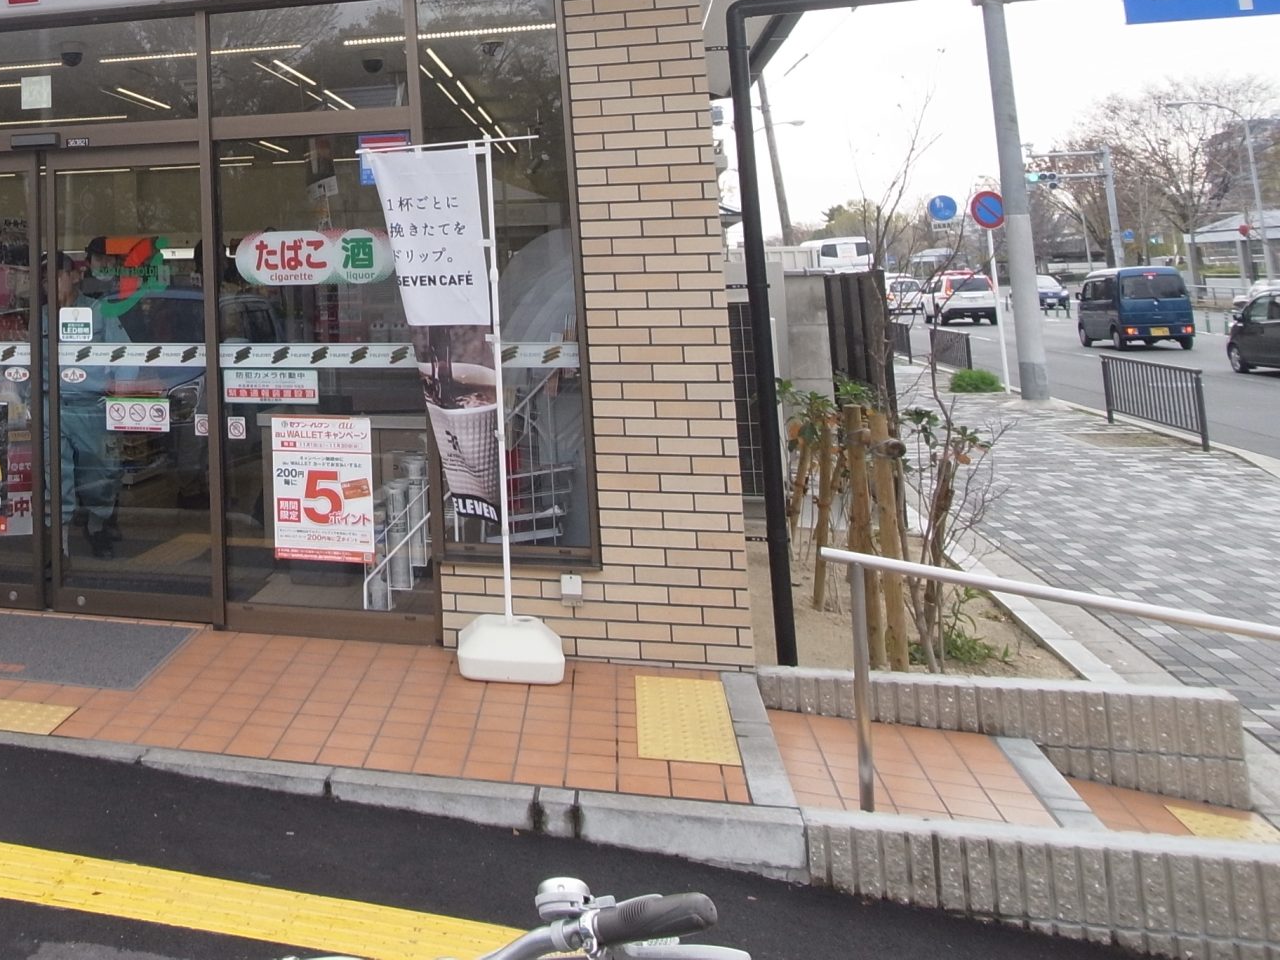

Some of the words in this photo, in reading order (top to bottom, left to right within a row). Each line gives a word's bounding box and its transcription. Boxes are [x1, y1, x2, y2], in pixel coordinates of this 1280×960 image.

[386, 195, 459, 212] 1杯ごとに
[389, 221, 466, 238] 挽きたてを
[255, 237, 327, 271] たばこ
[341, 237, 374, 269] 酒
[270, 272, 314, 283] cigarette
[346, 271, 376, 281] liquor
[439, 270, 474, 286] CAFÉ
[235, 371, 306, 380] 防犯カメラ作動中
[287, 430, 323, 439] WALLET
[324, 431, 368, 440] キャンペーン
[276, 468, 305, 479] 200円
[303, 470, 343, 524] 5
[328, 510, 371, 526] ポイント
